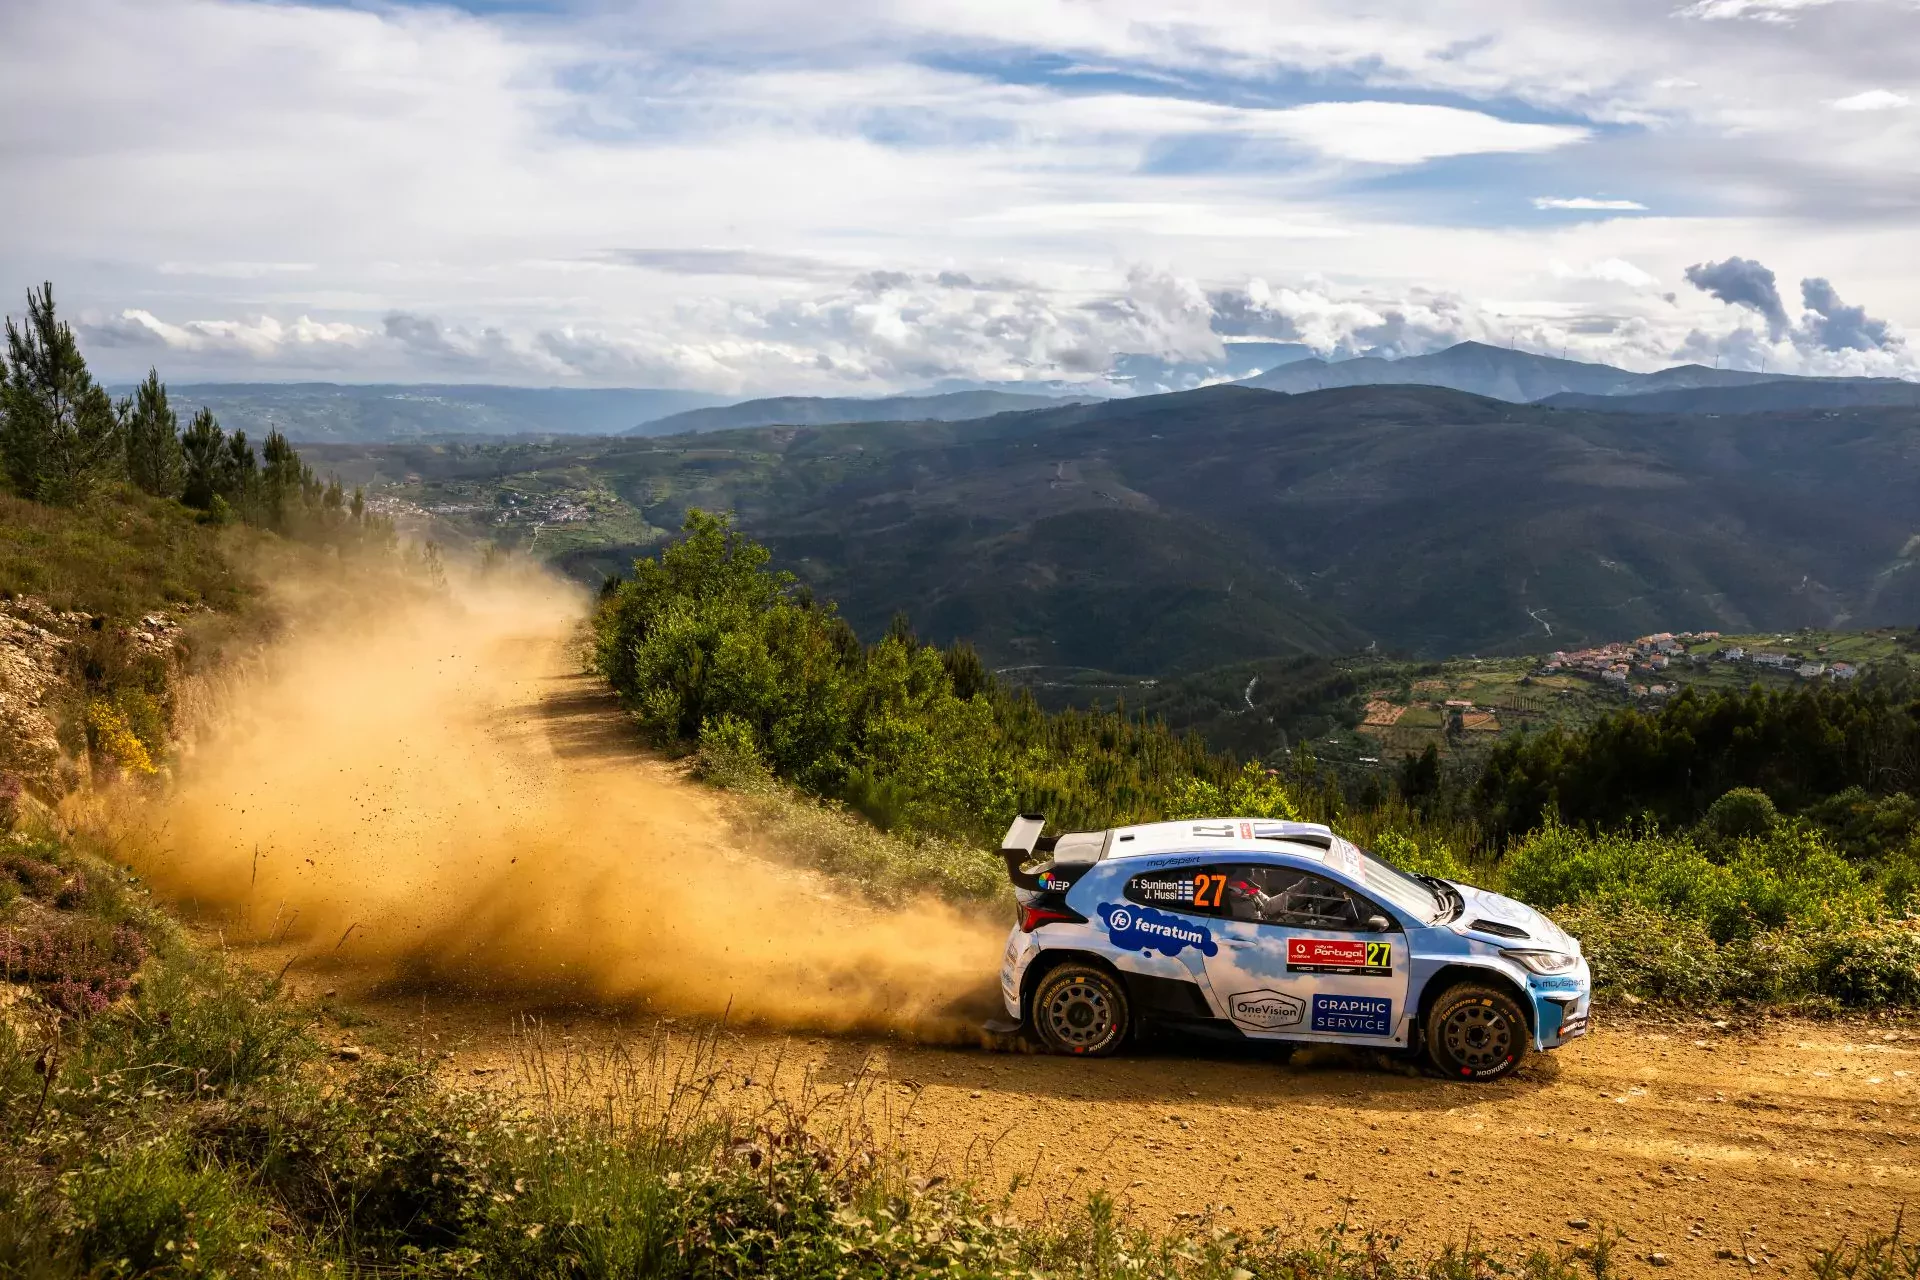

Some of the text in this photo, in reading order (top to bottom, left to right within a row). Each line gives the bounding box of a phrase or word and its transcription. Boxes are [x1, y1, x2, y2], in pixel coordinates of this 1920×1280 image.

[1047, 881, 1070, 890] NEP
[1131, 879, 1178, 890] T. Suninen
[1194, 874, 1227, 907] 27
[1144, 890, 1177, 900] J. Hussi
[1135, 918, 1203, 943] ferratum
[1314, 948, 1363, 958] Portugal
[1368, 943, 1391, 966] 27
[1237, 1003, 1297, 1016] OneVision
[1318, 1000, 1386, 1013] GRAPHIC
[1317, 1017, 1385, 1030] SERVICE
